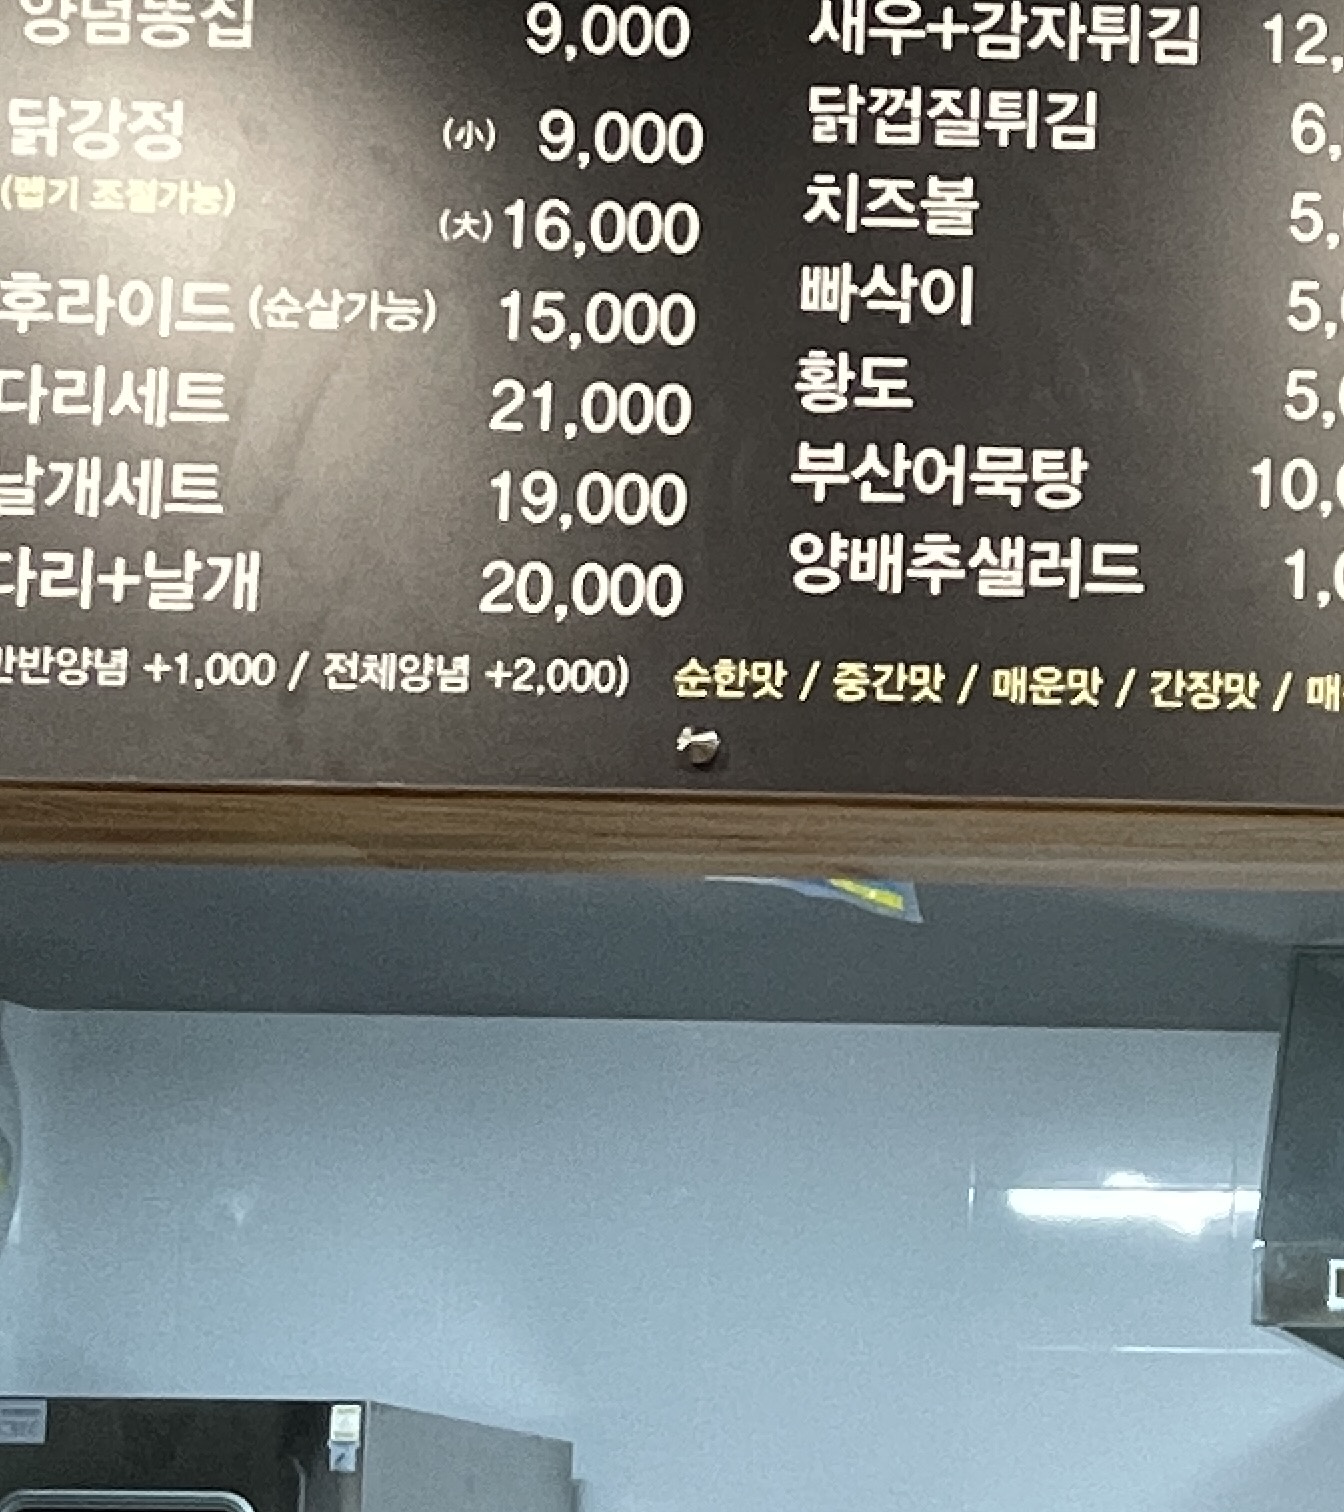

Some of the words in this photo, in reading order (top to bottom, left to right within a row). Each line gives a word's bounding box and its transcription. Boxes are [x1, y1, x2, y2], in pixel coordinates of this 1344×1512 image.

[526, 2, 690, 62] 9,000
[808, 0, 1200, 66] 새우+감자튀김
[8, 96, 184, 168] 닭강정
[538, 108, 704, 170] 9,000
[808, 84, 1098, 150] 닭껍질튀김
[439, 208, 492, 244] (大)
[504, 198, 700, 260] 16,000
[802, 172, 980, 236] 치즈볼
[0, 272, 236, 338] 후라이드
[248, 282, 436, 334] (순살가능)
[500, 288, 696, 350] 15,000
[800, 262, 974, 326] 빠삭이
[0, 364, 230, 428] 다리세트
[488, 378, 692, 440] 21,000
[794, 350, 914, 414] 황도
[490, 470, 688, 532] 19,000
[790, 440, 1090, 510] 부산어묵탕
[0, 546, 260, 612] 다리+날개
[478, 560, 683, 623] 20,000
[789, 532, 1144, 600] 양배추샐러드
[142, 652, 276, 690] +1,000
[288, 650, 310, 692] /
[322, 650, 470, 694] 전체양념
[484, 654, 629, 698] +2,000)
[674, 658, 788, 700] 순한맛
[798, 660, 820, 702] /
[832, 662, 946, 703] 중간맛
[956, 664, 978, 704] /
[992, 666, 1104, 708] 매운맛
[1114, 668, 1136, 708] /
[1150, 668, 1260, 710] 간장맛
[1272, 671, 1292, 712] /
